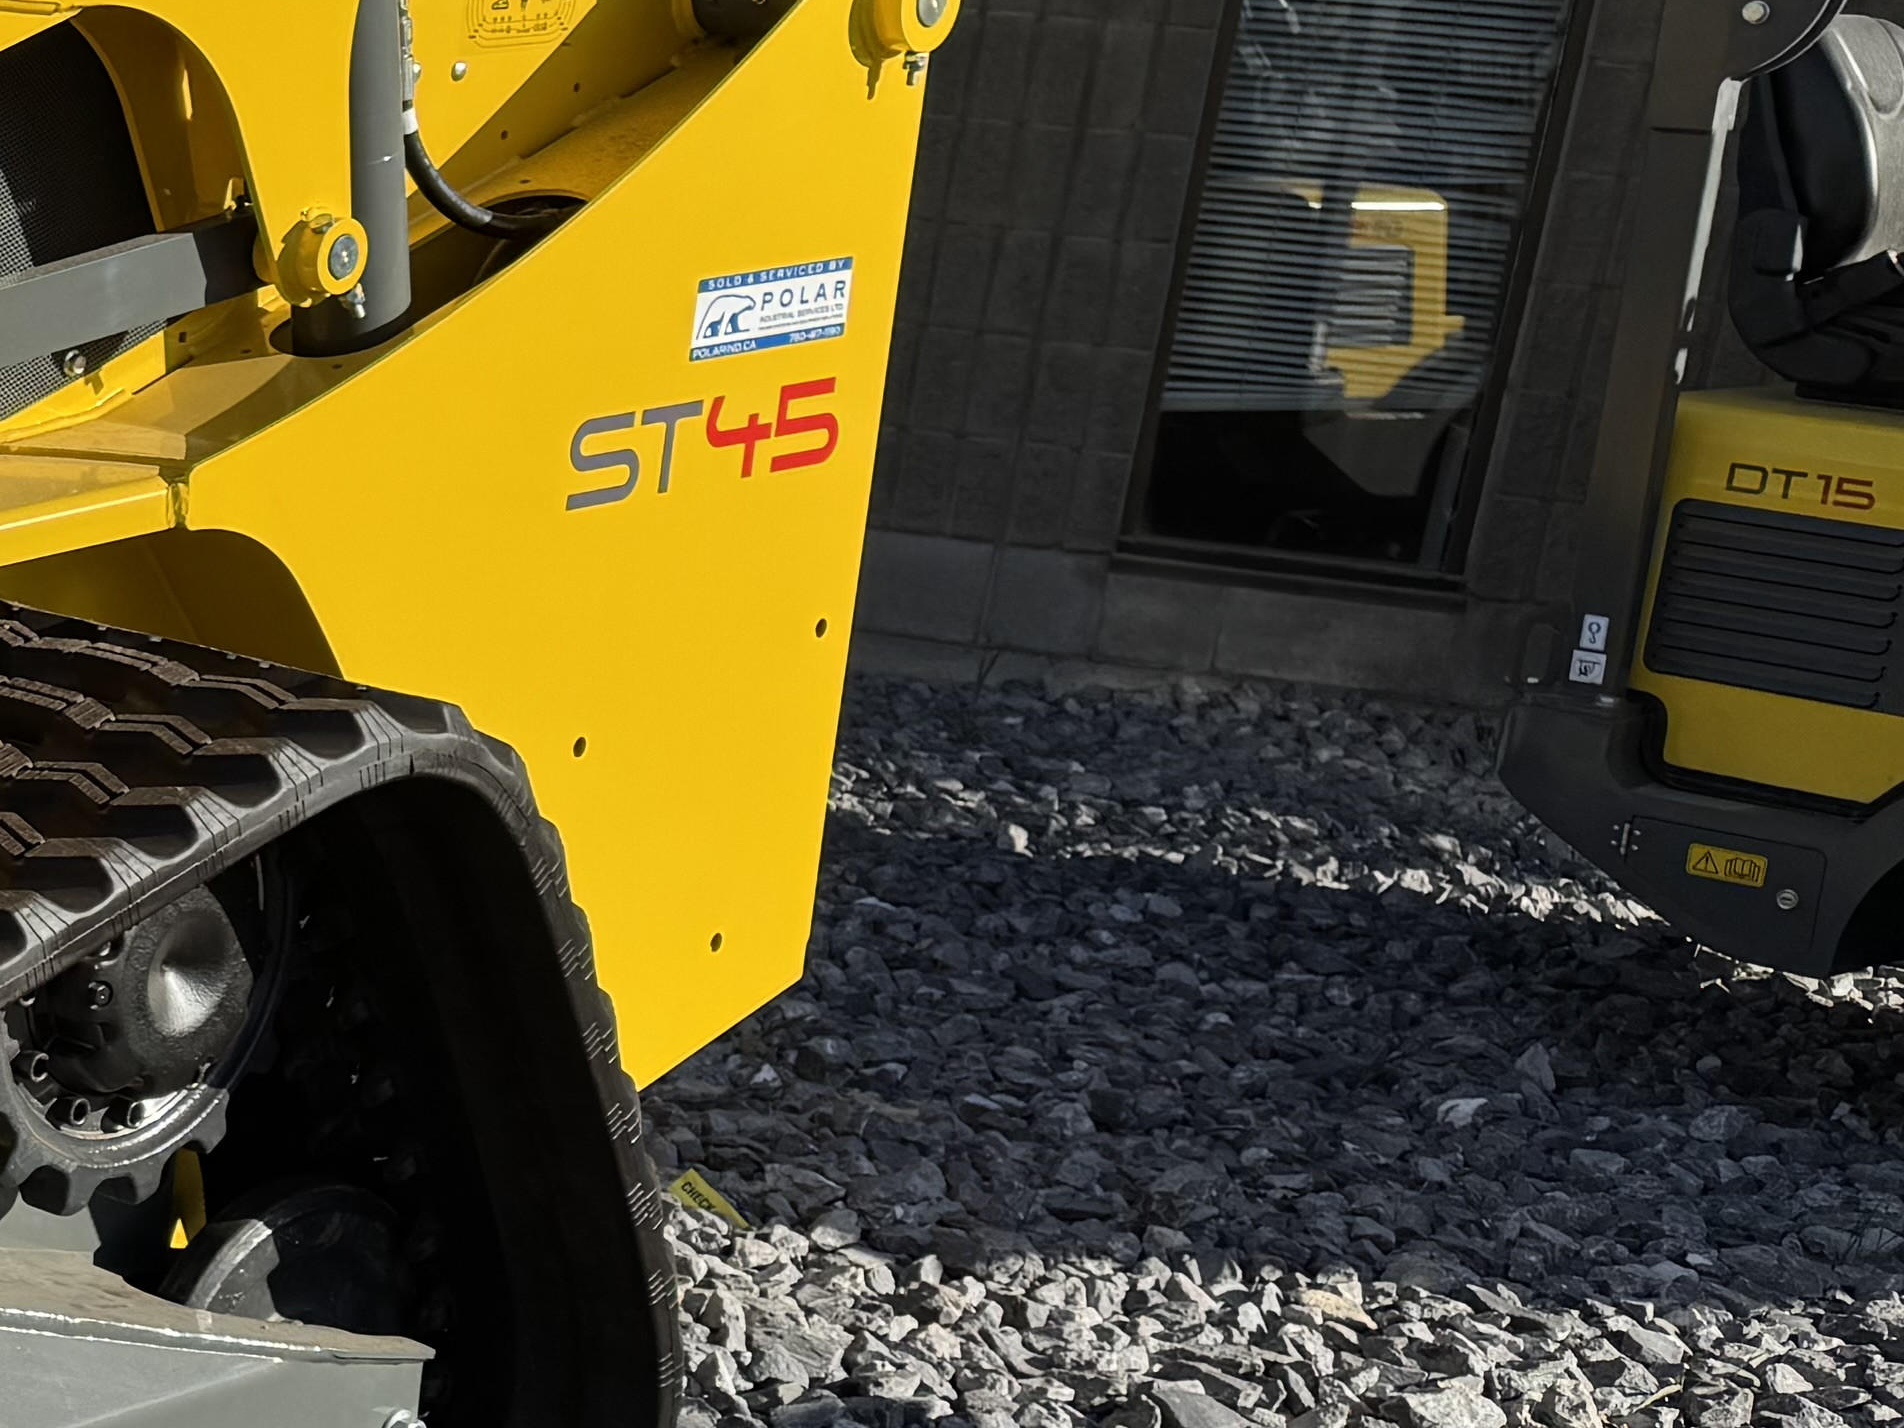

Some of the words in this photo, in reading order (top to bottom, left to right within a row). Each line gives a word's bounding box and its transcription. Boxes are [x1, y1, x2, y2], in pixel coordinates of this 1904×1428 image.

[708, 277, 742, 290] SOLD
[759, 263, 824, 282] SERVICED
[828, 259, 846, 271] BY
[760, 280, 847, 311] POLAR
[565, 376, 839, 511] ST45
